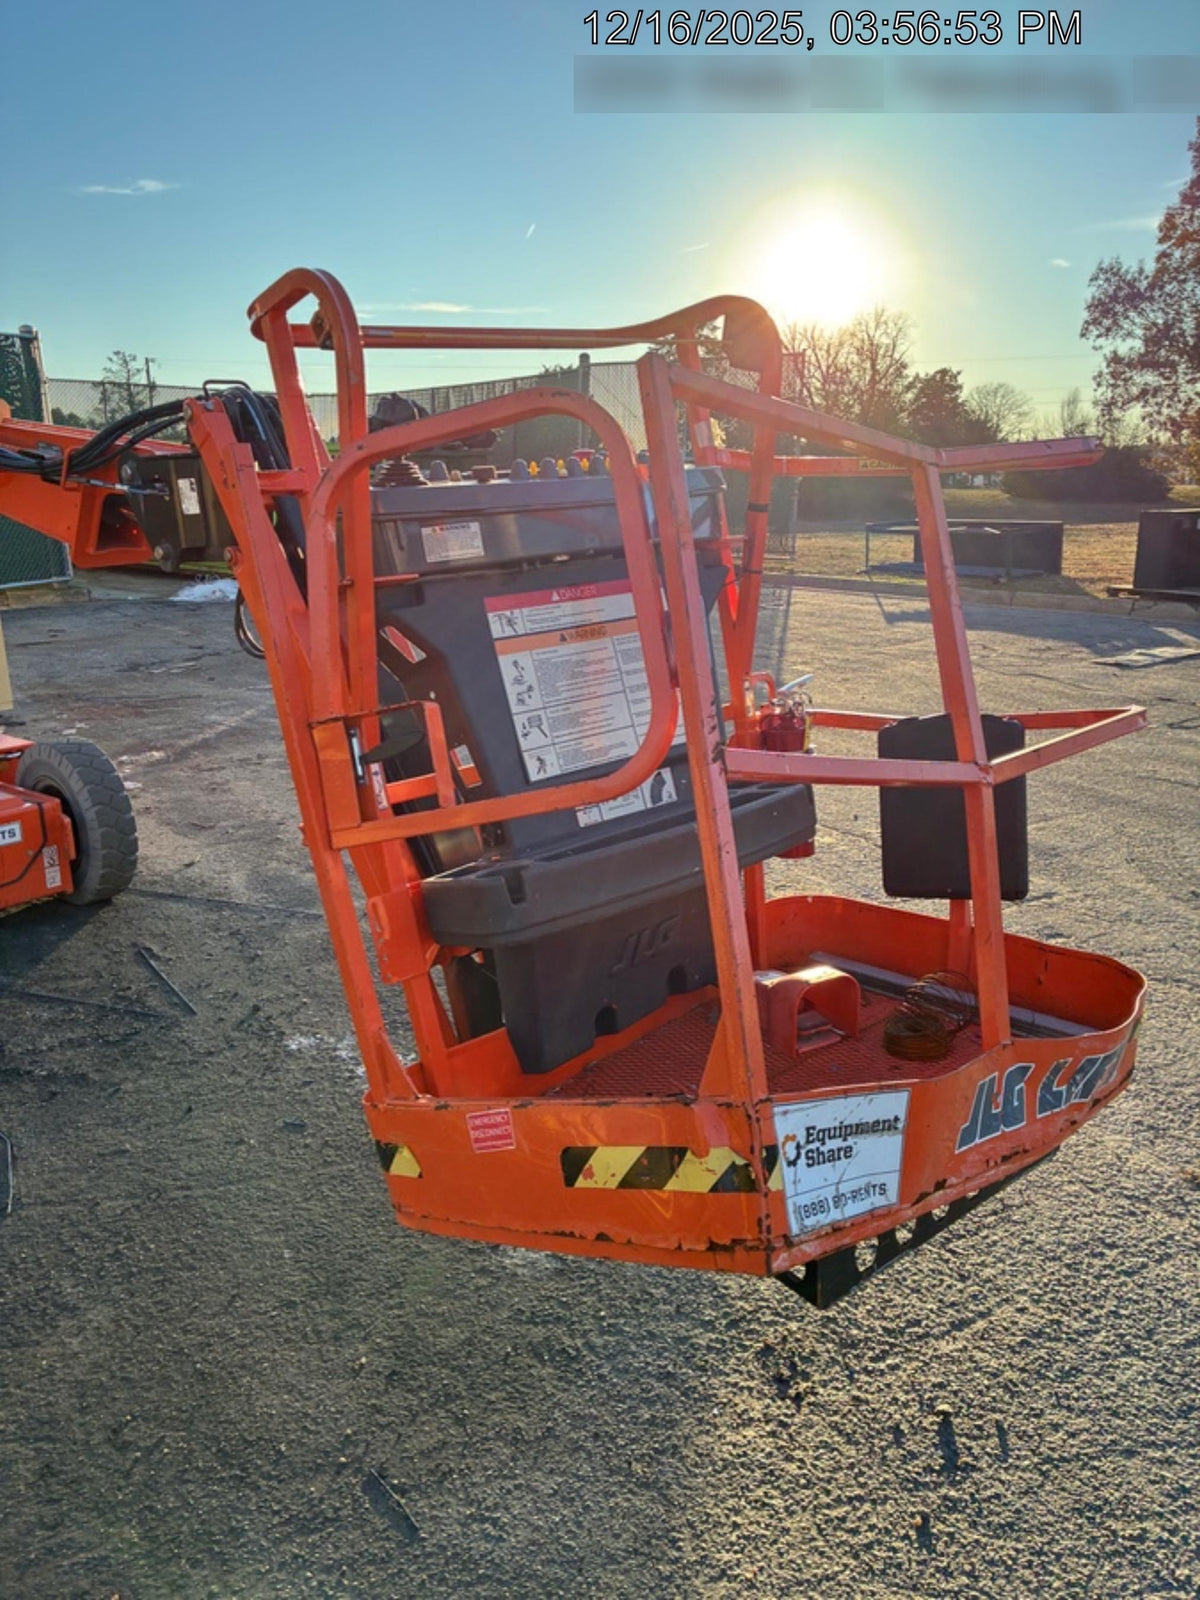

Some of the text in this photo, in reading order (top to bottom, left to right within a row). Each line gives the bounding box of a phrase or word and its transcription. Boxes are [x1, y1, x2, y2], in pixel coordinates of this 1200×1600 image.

[955, 1063, 1035, 1153] JLG
[805, 1115, 901, 1146] Equipment
[805, 1144, 853, 1168] Share
[797, 1197, 831, 1221] (888)
